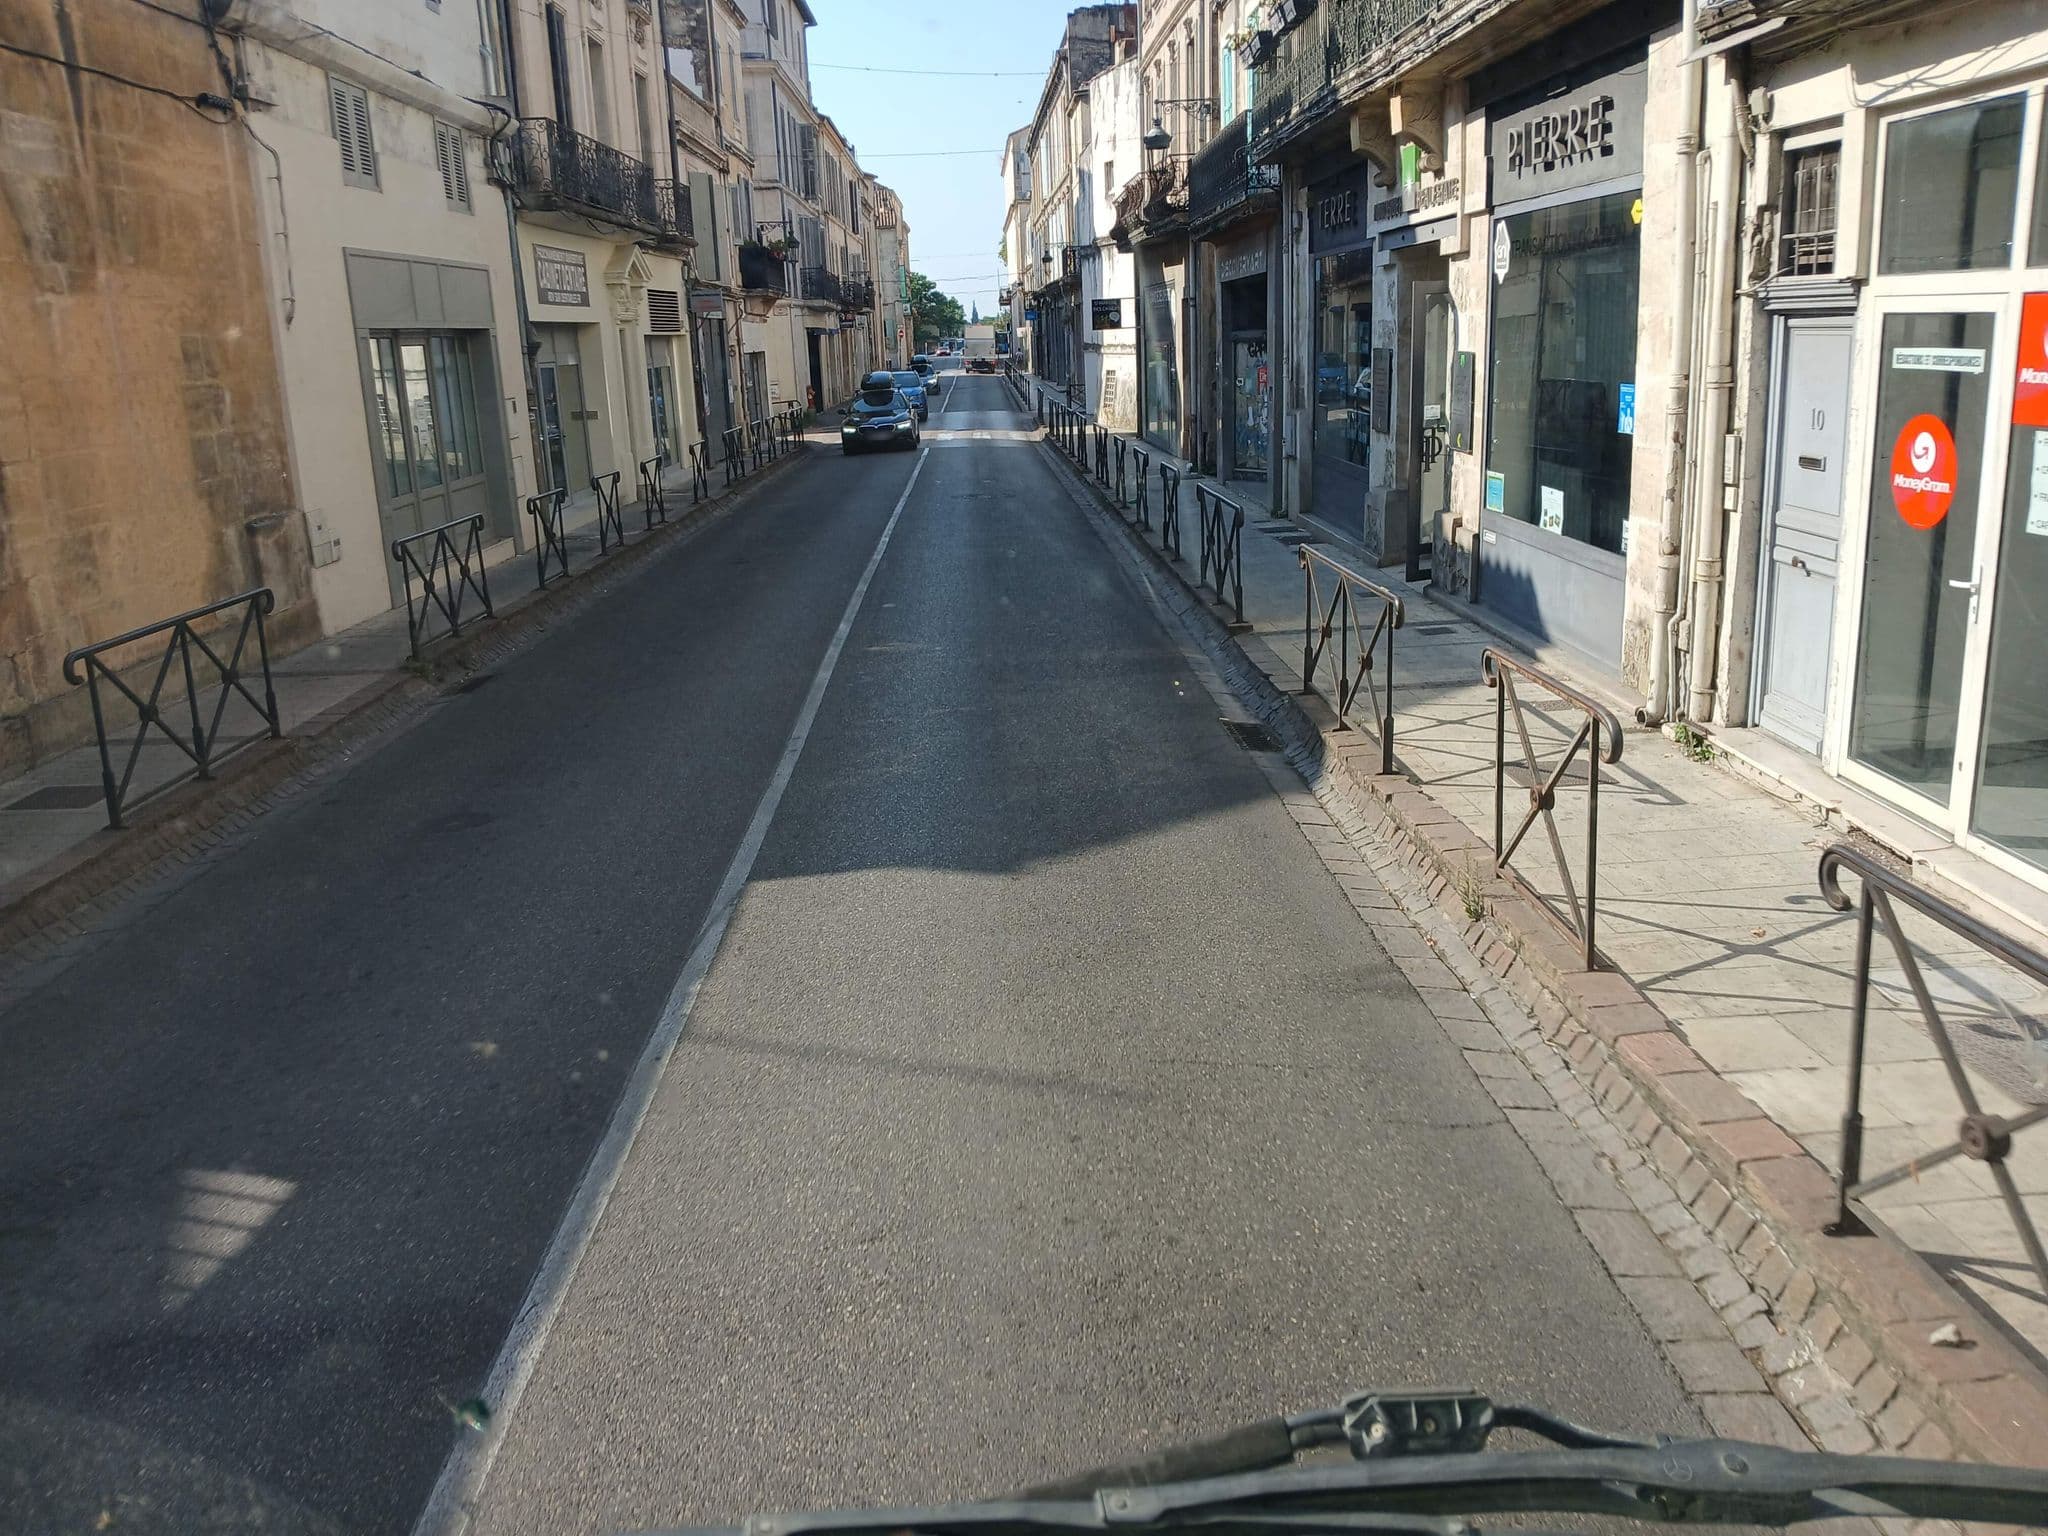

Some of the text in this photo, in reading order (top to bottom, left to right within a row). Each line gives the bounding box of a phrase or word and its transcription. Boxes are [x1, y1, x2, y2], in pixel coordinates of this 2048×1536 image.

[1507, 96, 1604, 172] PIERRE
[1318, 190, 1351, 228] TERRE
[1810, 408, 1825, 431] 10
[1893, 473, 1951, 493] MoneyGram
